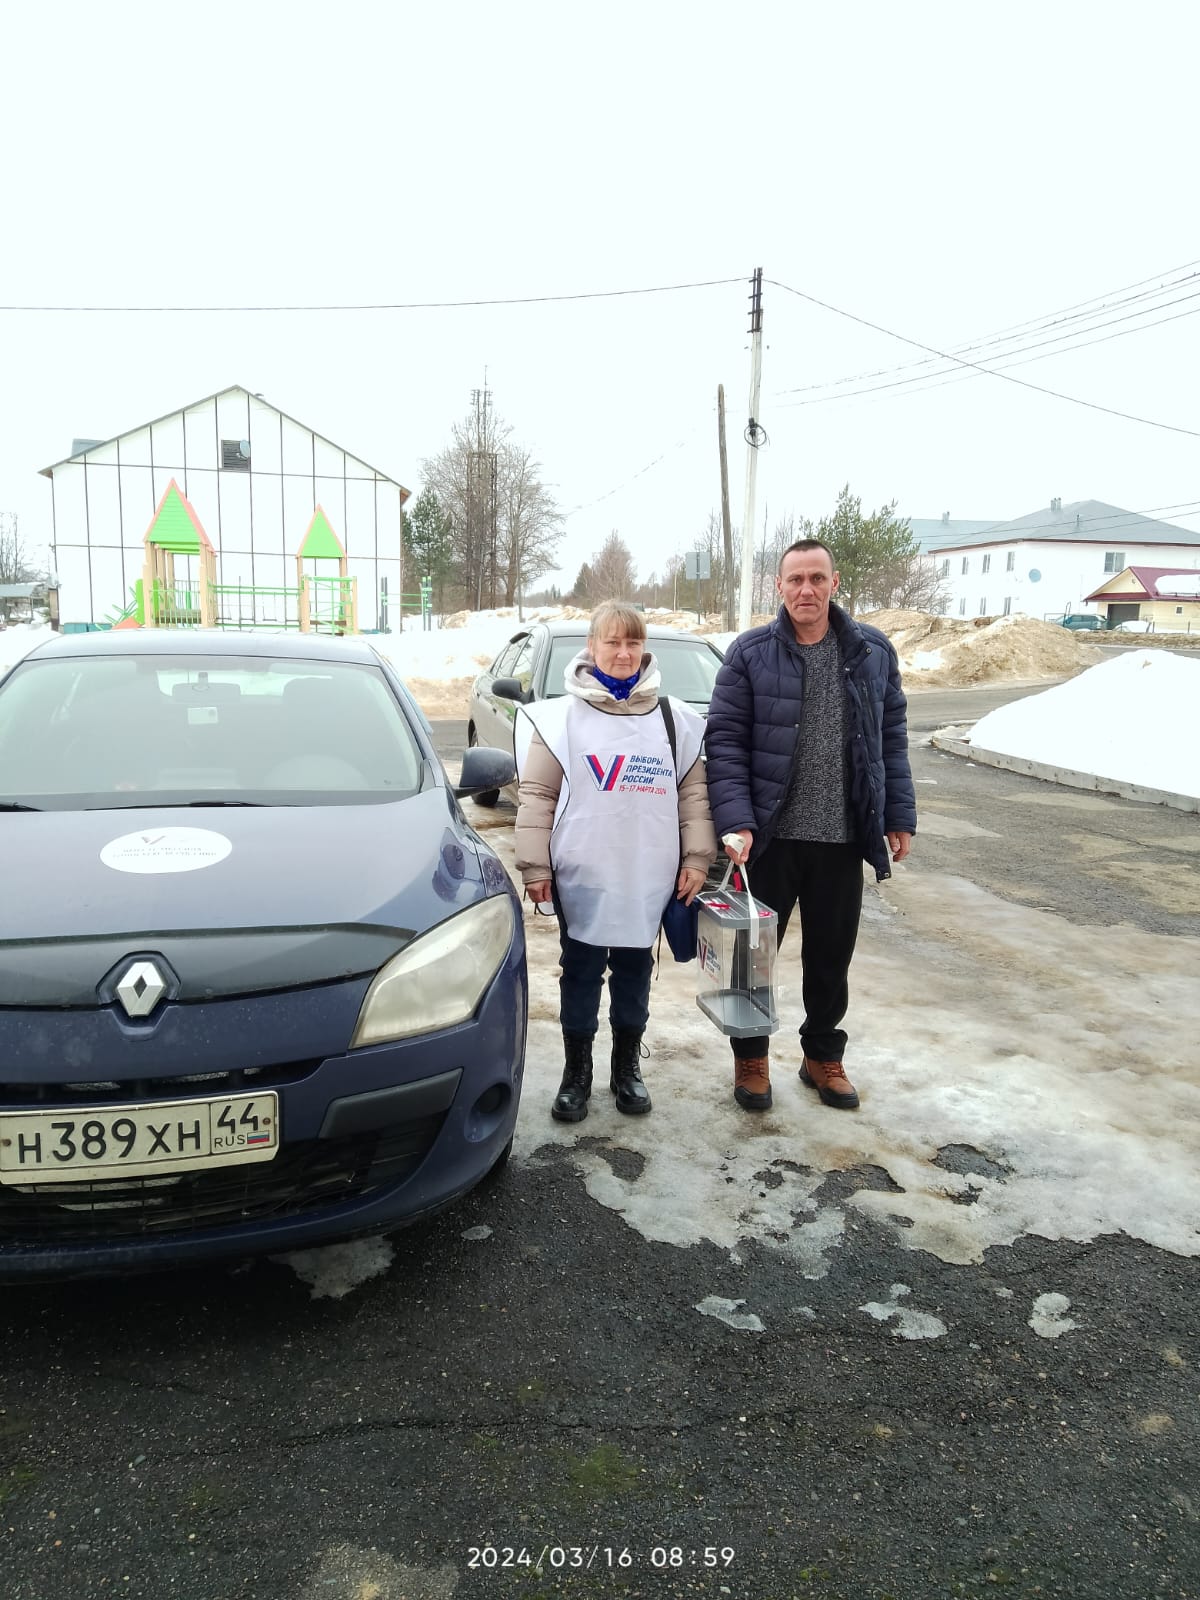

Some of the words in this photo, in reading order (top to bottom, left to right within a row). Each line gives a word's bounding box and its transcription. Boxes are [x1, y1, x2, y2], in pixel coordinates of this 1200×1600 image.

[630, 755, 664, 765] ВЫБОРЫ
[626, 765, 673, 777] ПРЕЗИДЕНТА
[622, 775, 655, 785] РОССИИ
[217, 1102, 259, 1134] 44
[214, 1134, 246, 1149] RUS
